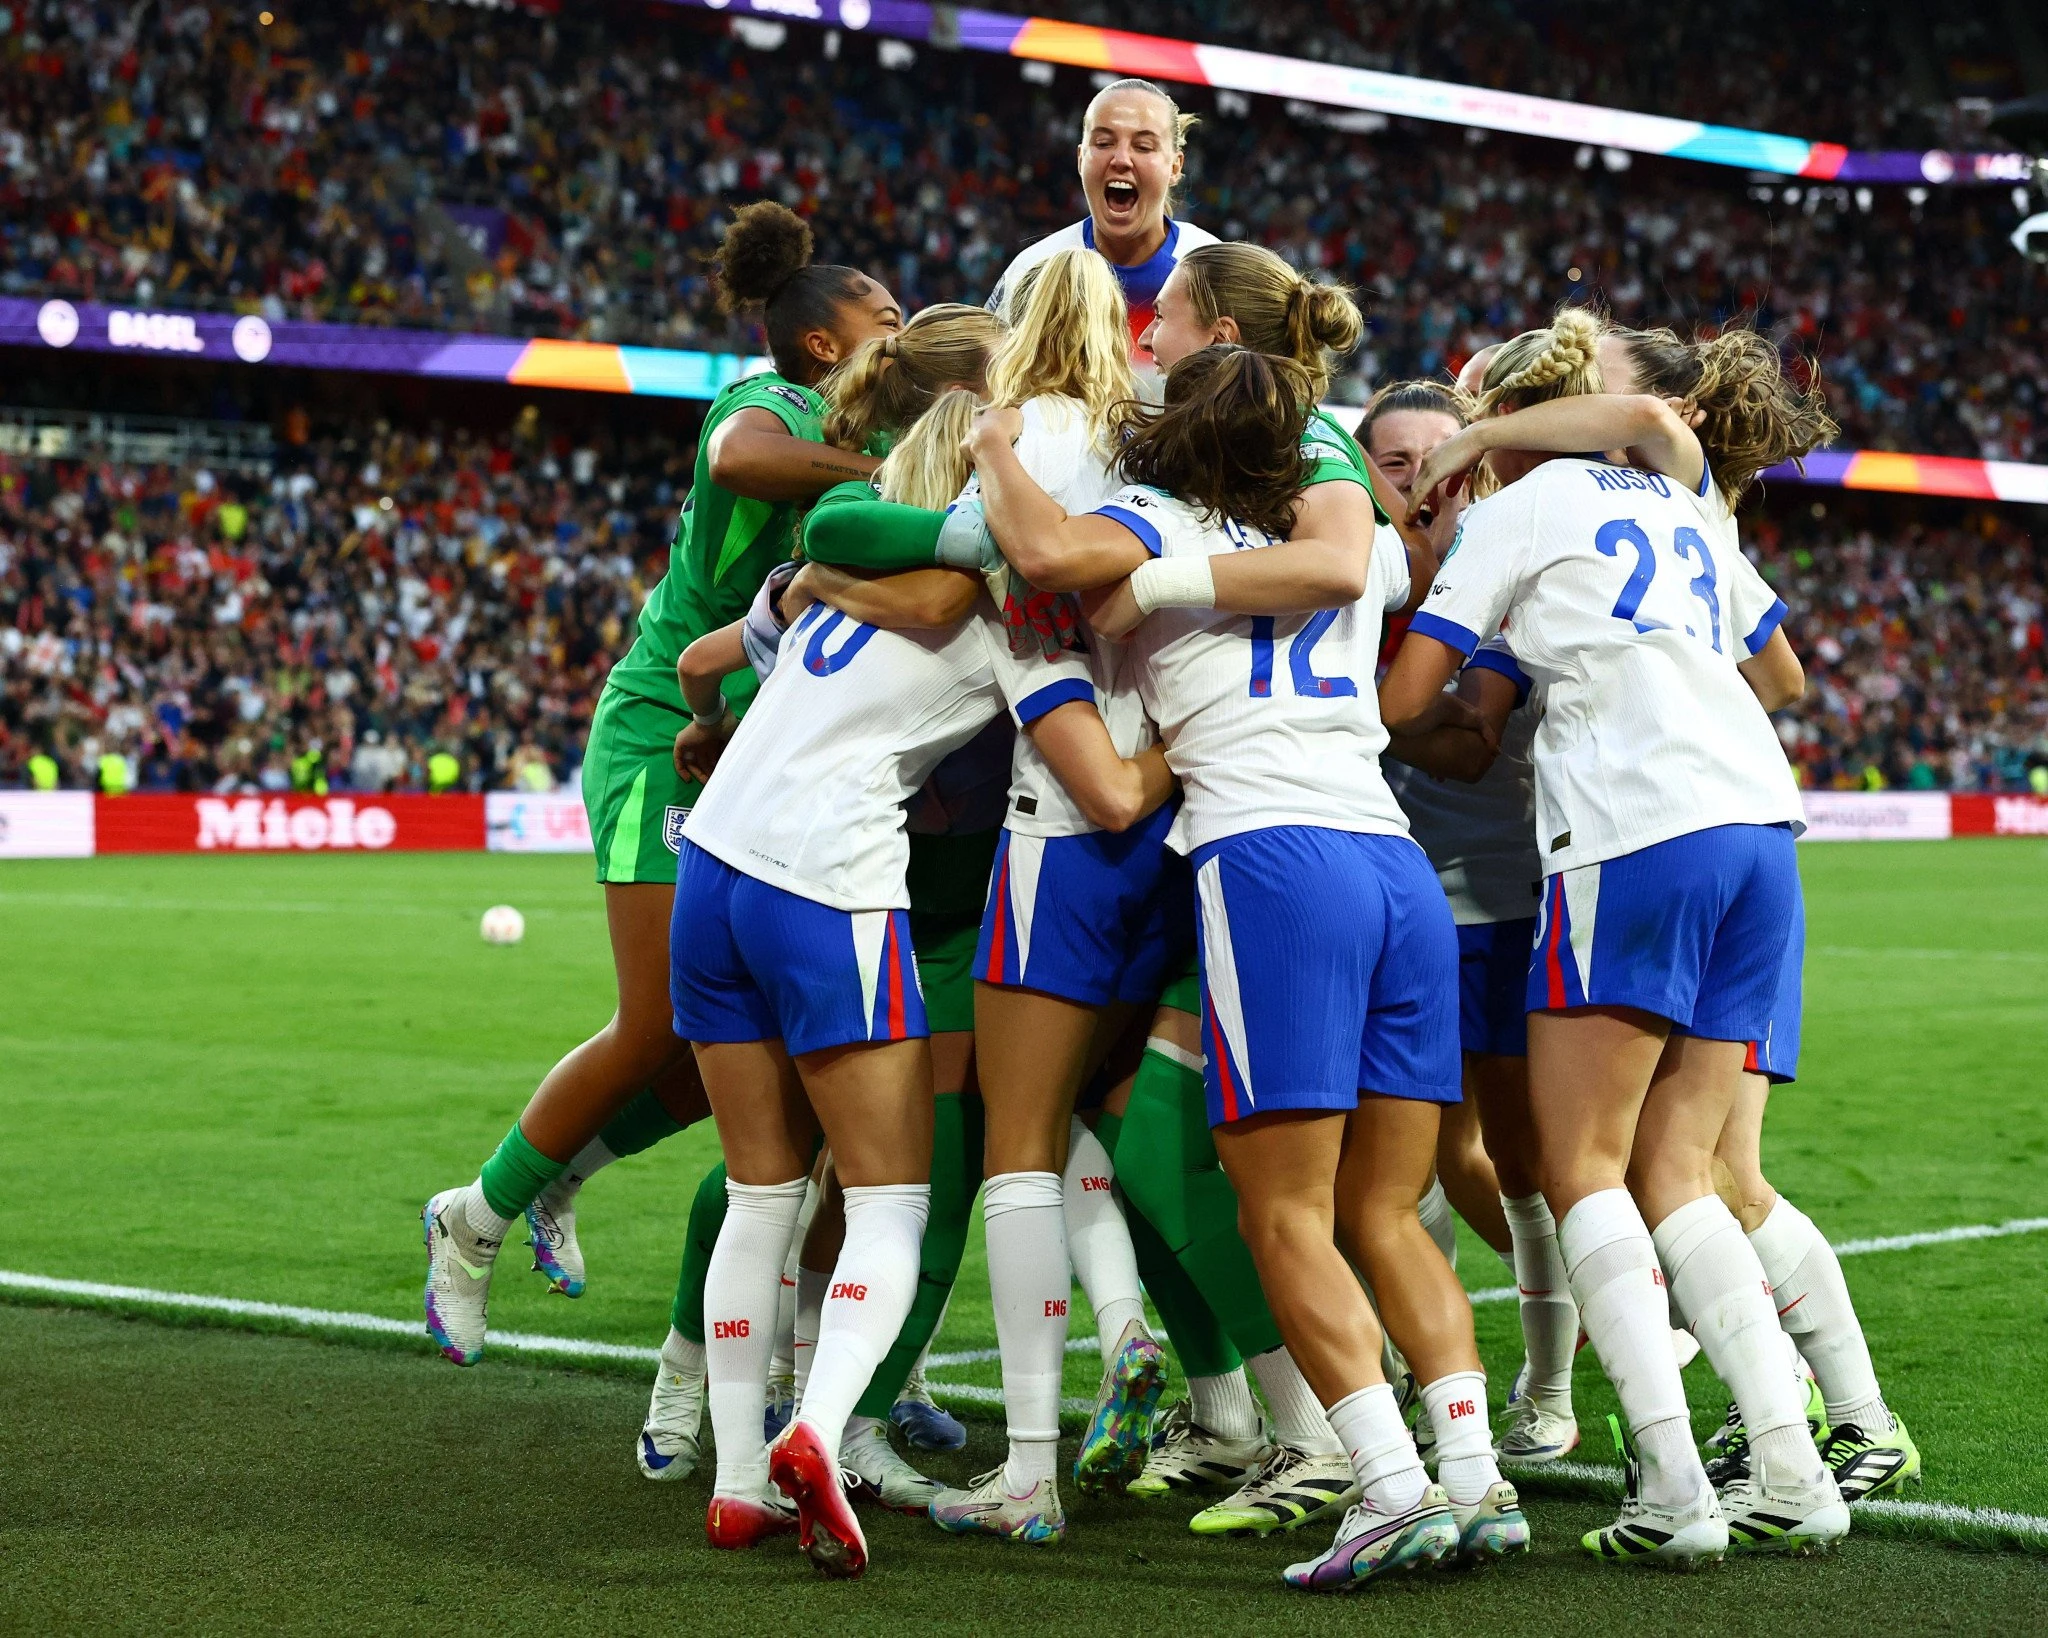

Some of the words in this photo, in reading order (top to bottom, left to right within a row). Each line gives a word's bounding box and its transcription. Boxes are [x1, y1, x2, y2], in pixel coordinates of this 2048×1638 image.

[1595, 518, 1723, 656] 23
[195, 799, 398, 850] Miele
[1080, 1176, 1110, 1192] ENG
[831, 1282, 868, 1301] ENG
[1044, 1299, 1067, 1317] ENG
[713, 1319, 750, 1339] ENG
[1448, 1400, 1475, 1420] ENG
